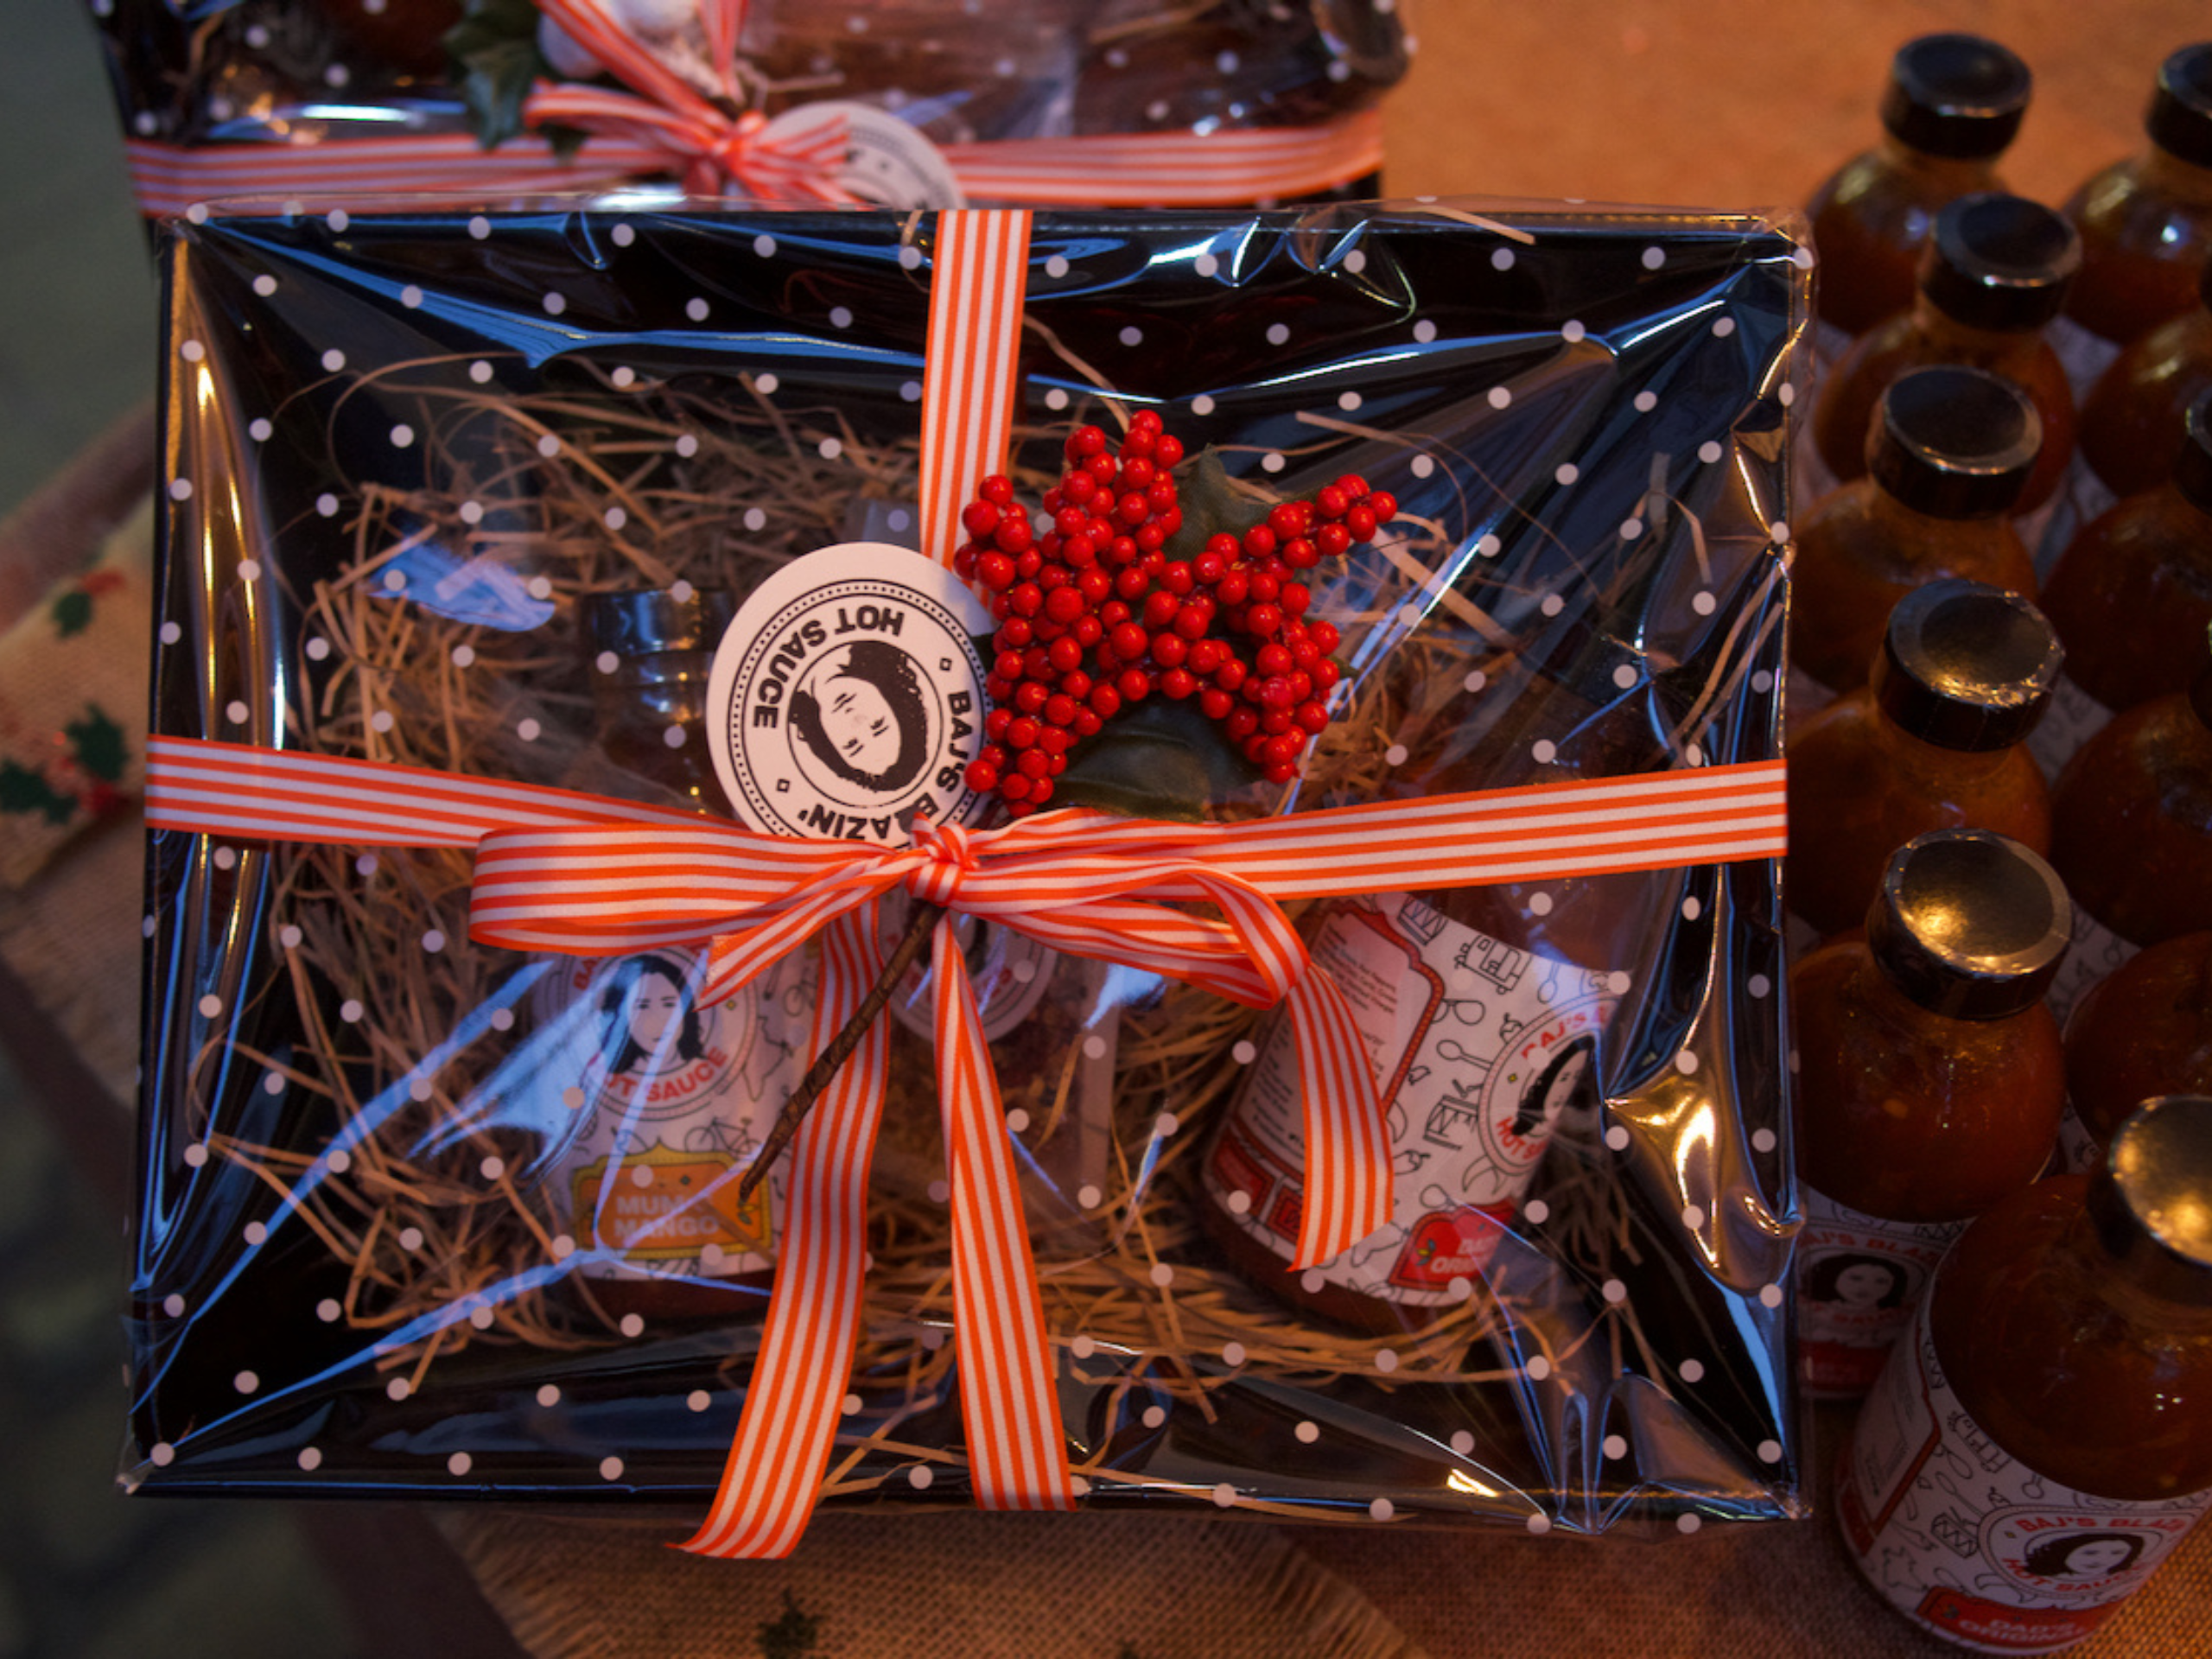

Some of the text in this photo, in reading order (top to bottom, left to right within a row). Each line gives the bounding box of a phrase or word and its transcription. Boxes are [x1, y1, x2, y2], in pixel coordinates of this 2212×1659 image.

[753, 605, 906, 729] HOT SAUCE
[936, 690, 974, 793] BAJ'S
[646, 1046, 728, 1103] SAUCE
[2015, 1516, 2097, 1533] BAJ'S
[2002, 1558, 2054, 1586] HOT
